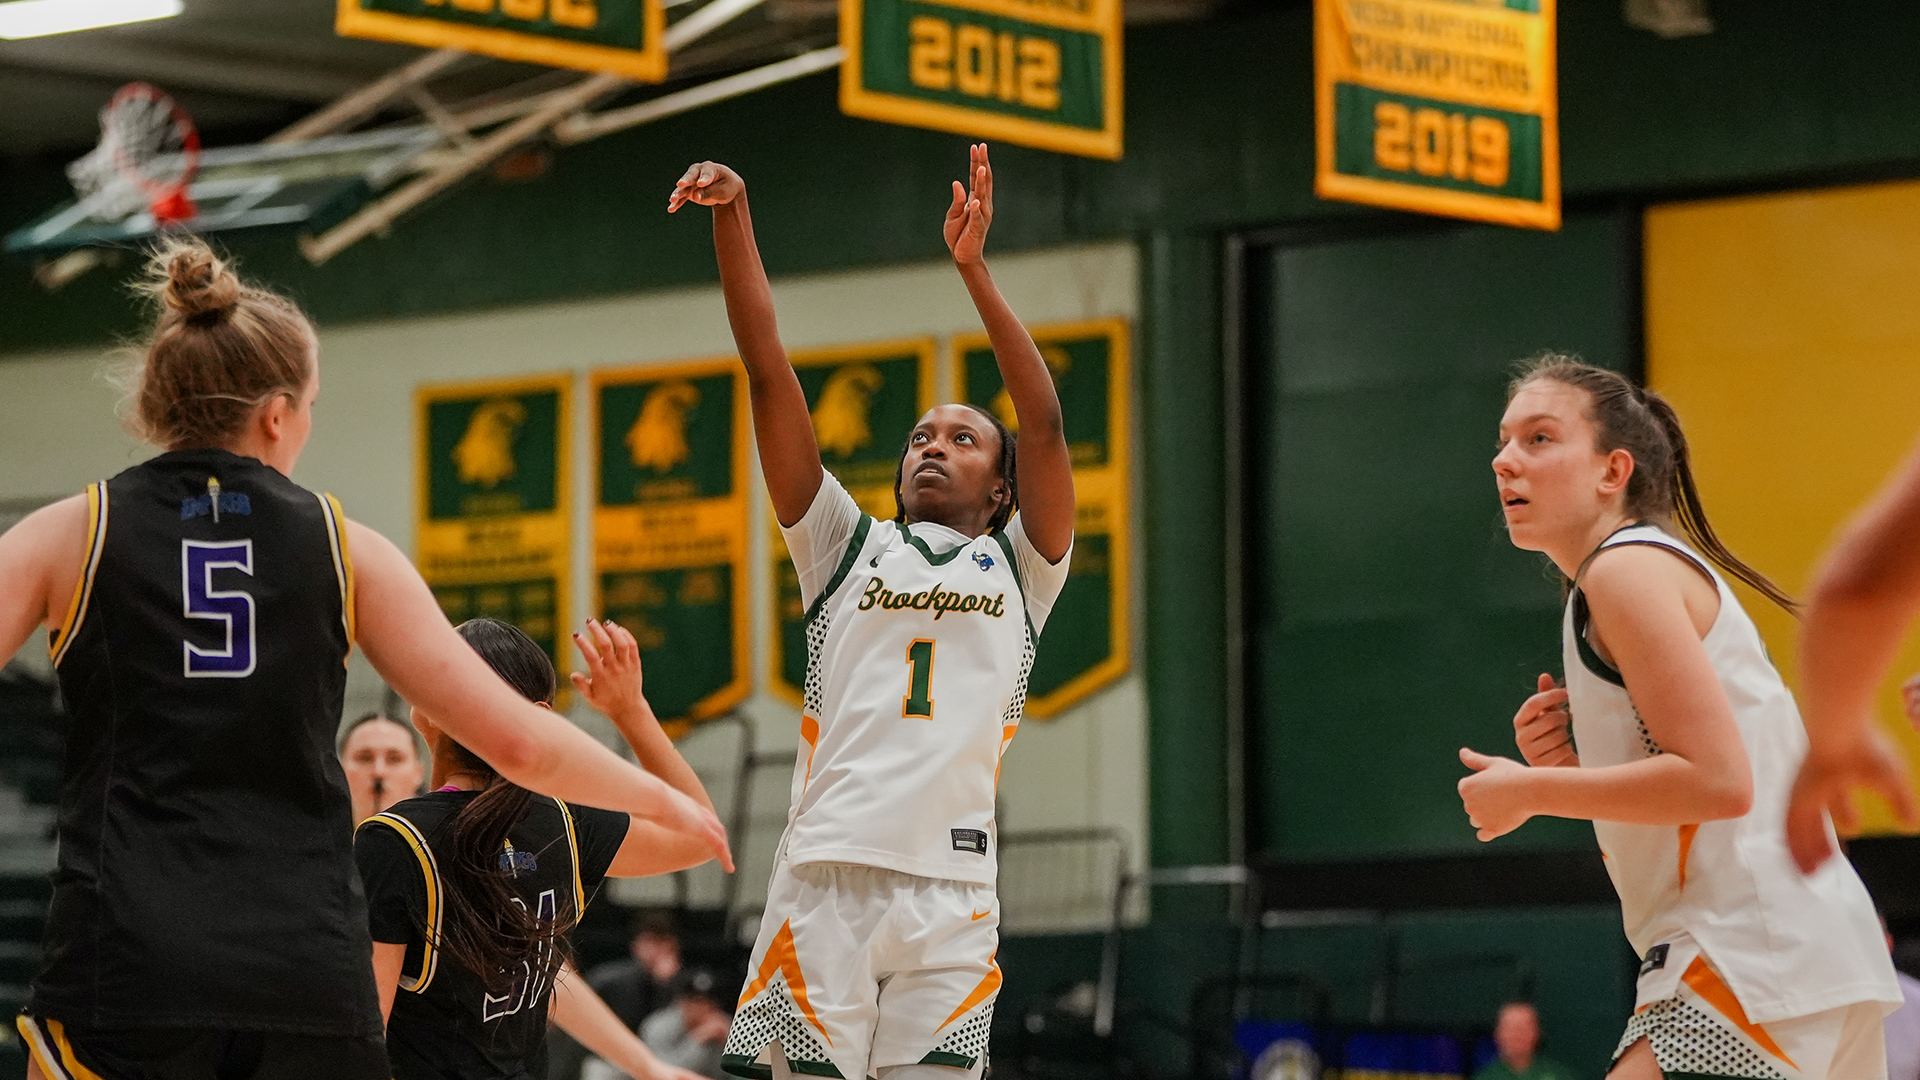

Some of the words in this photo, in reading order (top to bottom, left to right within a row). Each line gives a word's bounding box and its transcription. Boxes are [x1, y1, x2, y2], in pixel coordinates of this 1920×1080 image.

[908, 16, 1061, 111] 2012
[1374, 101, 1510, 188] 2019
[181, 538, 257, 679] 5
[858, 576, 1005, 621] Brockport
[902, 637, 936, 721] 1
